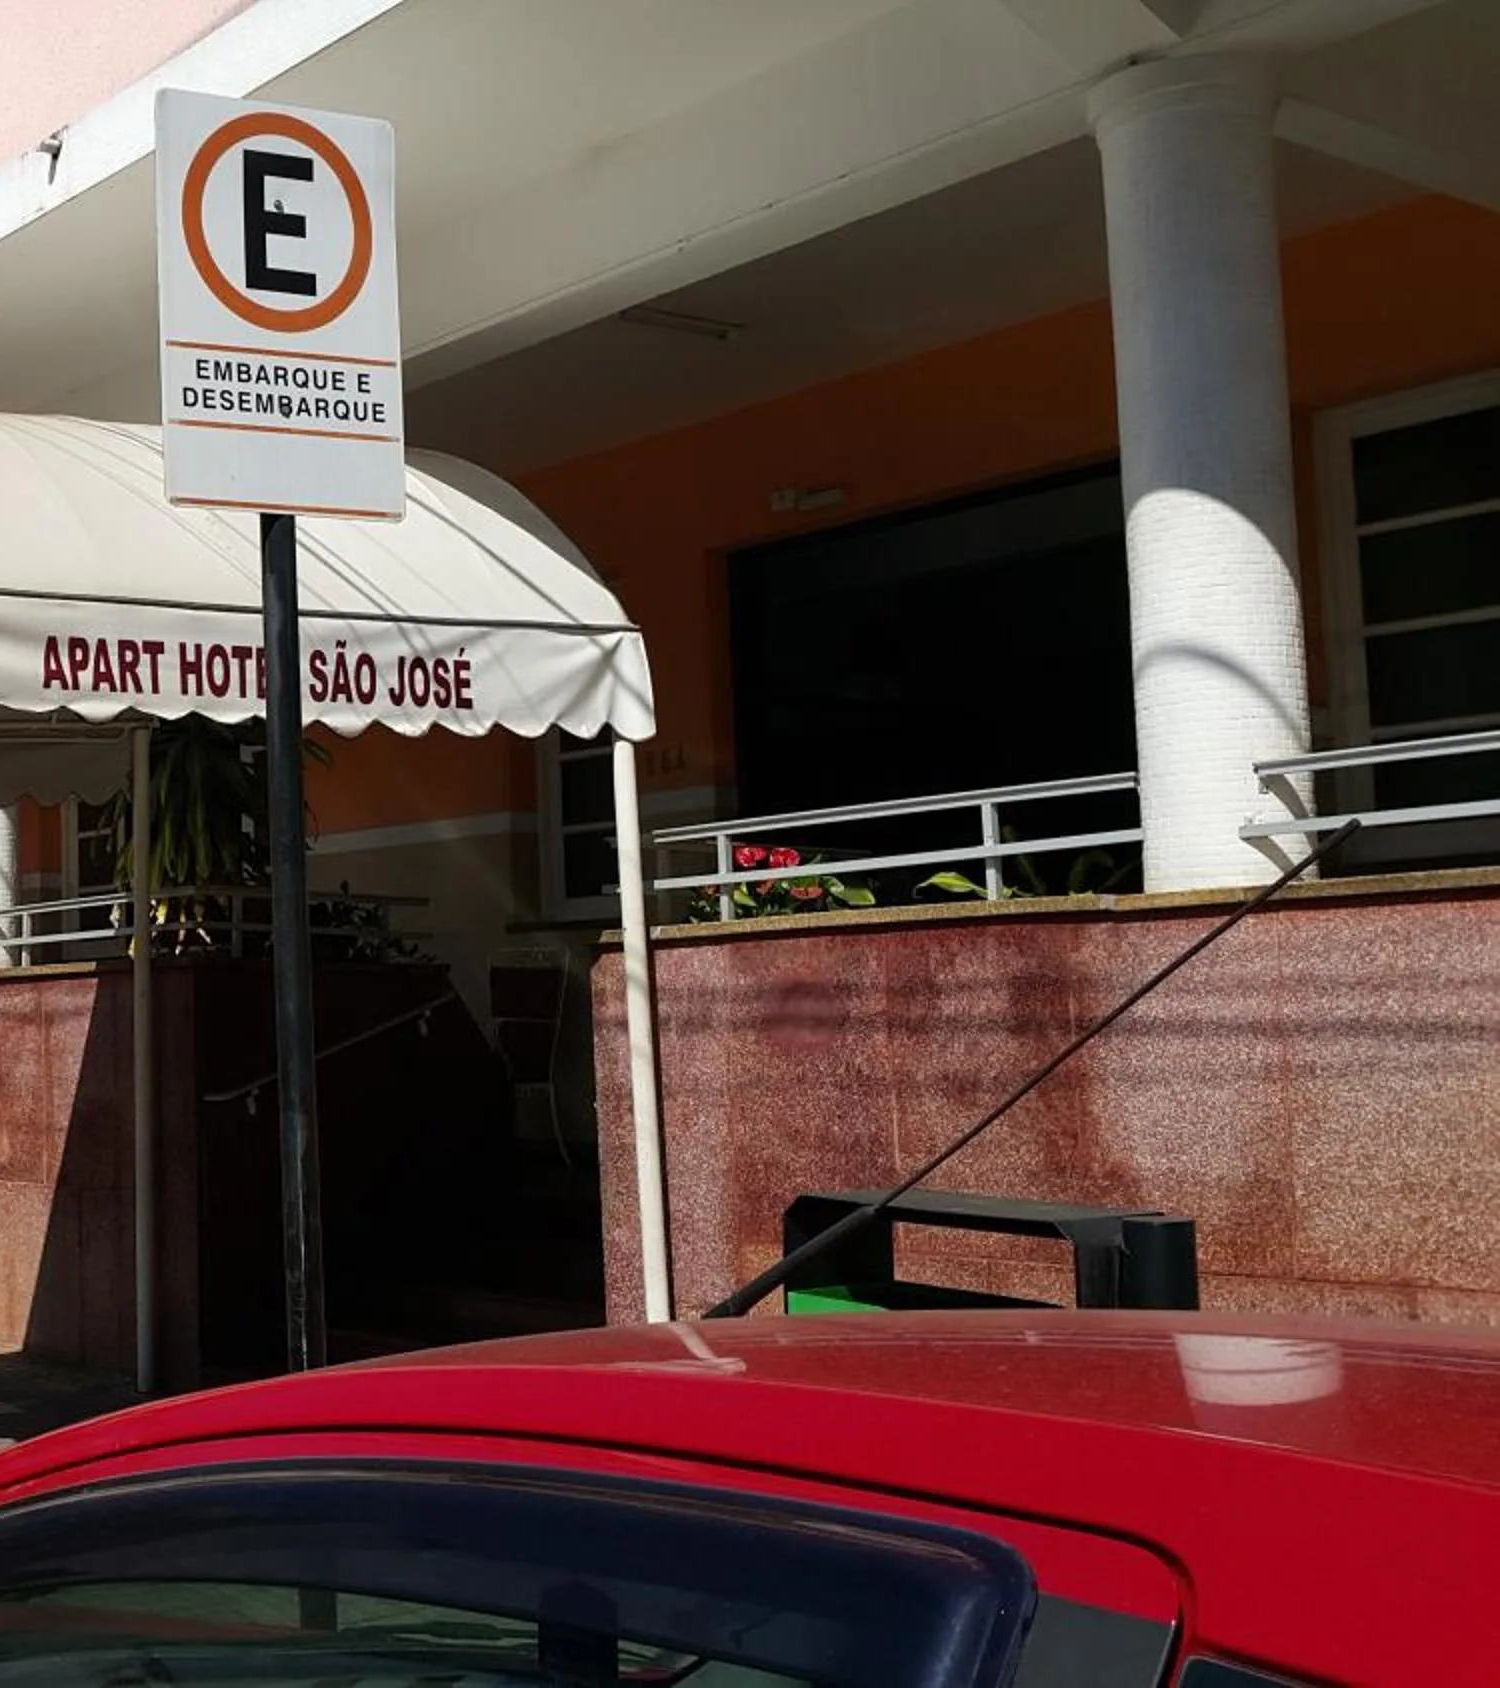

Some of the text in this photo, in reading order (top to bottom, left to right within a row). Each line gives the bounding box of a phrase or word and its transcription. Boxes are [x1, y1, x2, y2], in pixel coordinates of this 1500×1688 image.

[243, 149, 317, 297] E
[195, 358, 372, 394] EMBARQUE E
[182, 386, 387, 423] DESEMBARQUE
[43, 635, 474, 710] APART HOTE SÃO JOSÉ
